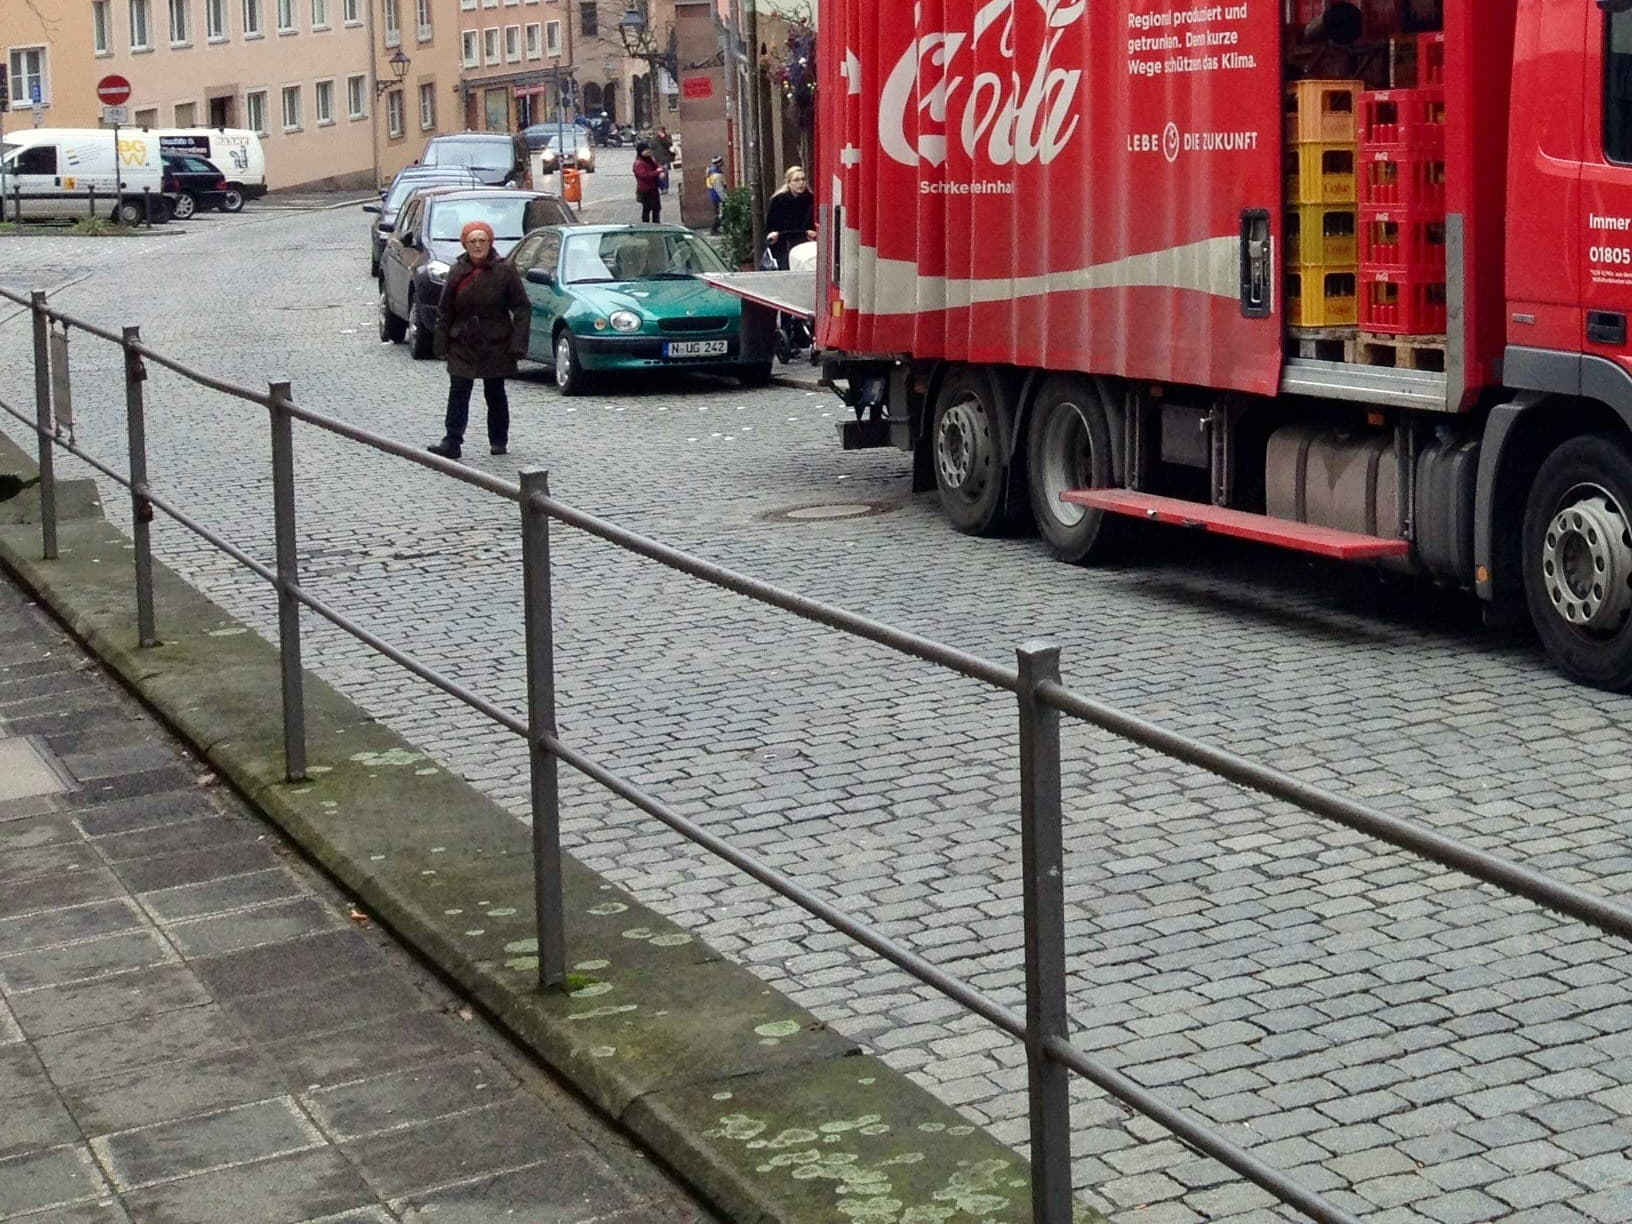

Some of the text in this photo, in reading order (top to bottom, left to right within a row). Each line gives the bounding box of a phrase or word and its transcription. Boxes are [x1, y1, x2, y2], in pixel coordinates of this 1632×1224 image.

[1225, 2, 1248, 19] und
[1206, 30, 1238, 45] kurze
[1128, 58, 1162, 76] Wege
[1221, 52, 1257, 69] Klima.
[1127, 131, 1258, 152] LEBE DIE ZUKUNFT
[1589, 213, 1631, 230] Immer
[671, 341, 725, 354] N UG 242
